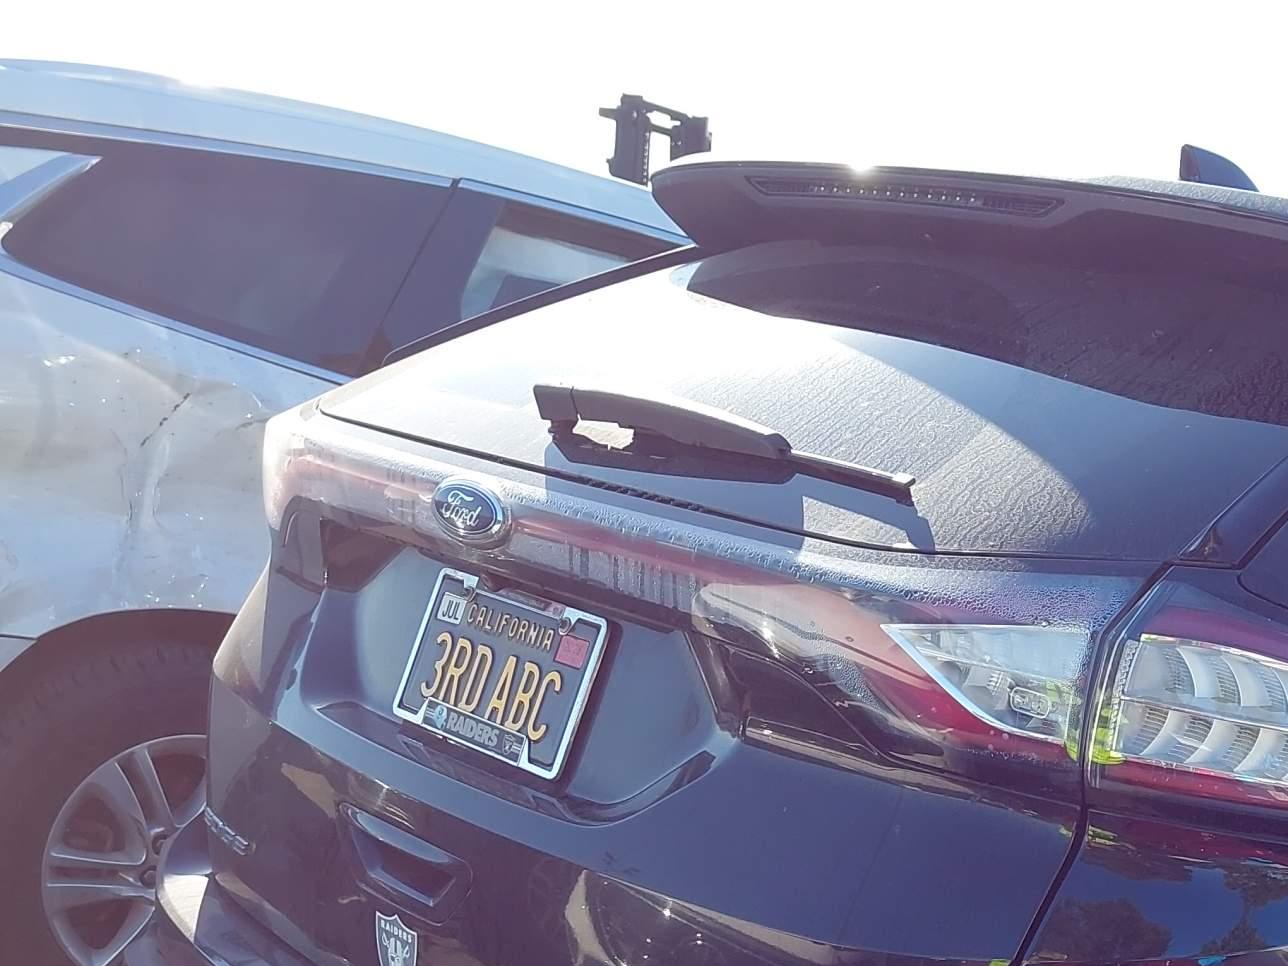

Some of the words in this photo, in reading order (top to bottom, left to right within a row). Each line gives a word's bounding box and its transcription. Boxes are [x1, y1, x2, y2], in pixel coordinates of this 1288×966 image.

[441, 490, 482, 527] Ford
[441, 599, 460, 621] JUL
[467, 604, 555, 651] CALIFORNIA
[420, 631, 493, 713] 3RD
[484, 655, 562, 741] ABC
[446, 711, 500, 747] RAIDERS
[380, 919, 413, 943] RAIDERS
